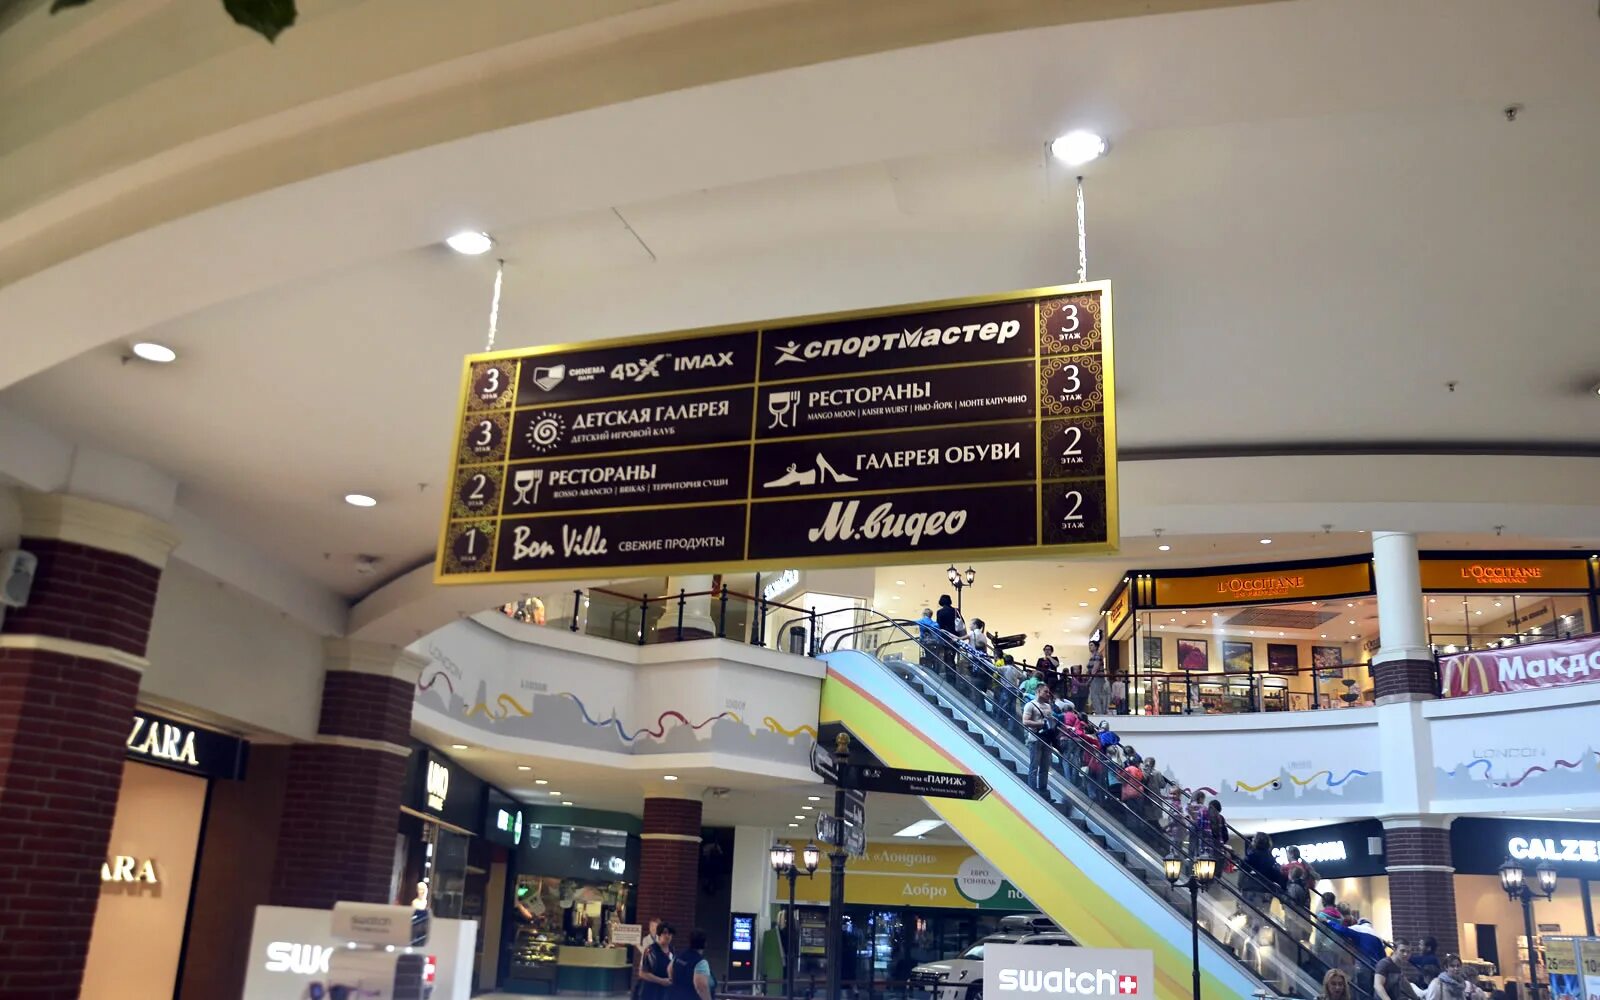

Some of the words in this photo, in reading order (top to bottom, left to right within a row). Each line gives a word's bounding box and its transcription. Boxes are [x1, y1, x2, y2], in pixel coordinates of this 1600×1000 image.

[1061, 304, 1080, 333] 3
[674, 351, 734, 372] IMAX
[483, 368, 499, 393] 3
[1063, 364, 1081, 394] 3
[808, 381, 931, 407] РЕСТОРАНЫ
[572, 408, 651, 430] ДЕТСКАЯ
[655, 400, 730, 421] ГАЛЕРЕЯ
[807, 410, 833, 421] MANGO
[834, 409, 856, 419] MOON
[862, 406, 884, 417] KAISER
[885, 404, 908, 415] WURST
[914, 400, 953, 412] НЬЮ-ЙОРК
[959, 398, 984, 408] МОНТЕ
[985, 394, 1027, 405] КАПУЧИНО
[477, 420, 492, 446] 3
[570, 430, 609, 443] ДЕТСКИЙ
[611, 426, 650, 440] ИГРОВОЙ
[652, 426, 676, 436] КЛУБ
[1063, 426, 1082, 455] 2
[856, 448, 939, 471] ГАЛЕРЕЯ
[945, 441, 1020, 464] ОБУВИ
[1061, 456, 1083, 464] ЭТАЖ
[469, 474, 486, 499] 2
[548, 463, 657, 486] РЕСТОРАНЫ
[653, 481, 701, 491] ТЕРРИТОРИЯ
[702, 478, 728, 488] СУШИ
[1064, 490, 1083, 520] 2
[808, 499, 967, 545] М.видео
[1062, 521, 1084, 529] ЭТАЖ
[465, 528, 477, 554] 1
[513, 525, 554, 561] Bon
[562, 523, 608, 558] Ville
[618, 540, 662, 552] СВЕЖИЕ
[664, 536, 725, 550] ПРОДУКТЫ
[1217, 576, 1305, 593] L'OCCITANE
[1461, 565, 1542, 578] L'OCCITANE
[126, 716, 199, 766] ZARA
[923, 774, 966, 787] «ПАРИЖ»
[1508, 836, 1600, 862] CALZE
[902, 882, 947, 899] Добро
[998, 967, 1117, 995] swatch
